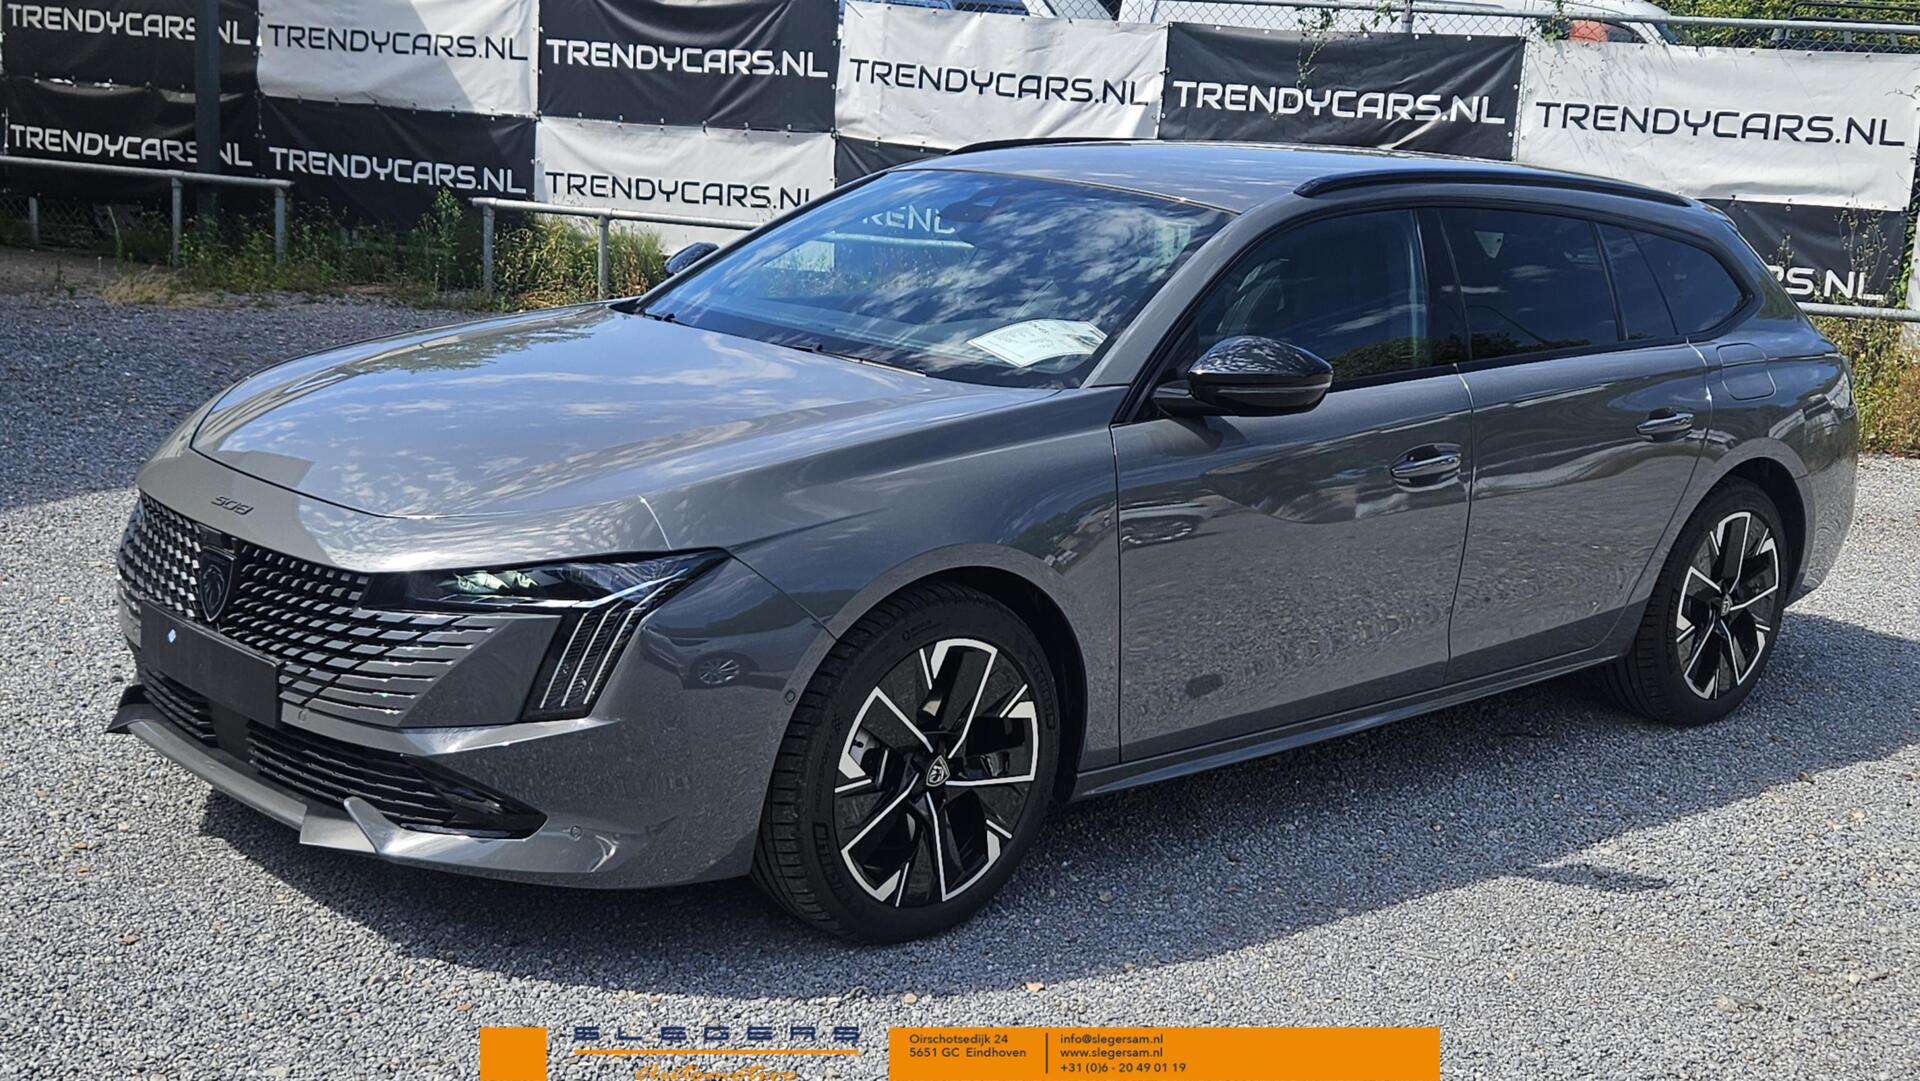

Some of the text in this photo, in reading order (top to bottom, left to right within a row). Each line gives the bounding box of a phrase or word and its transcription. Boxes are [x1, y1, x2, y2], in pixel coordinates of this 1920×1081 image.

[8, 3, 252, 46] TRENDYCARSNL
[267, 24, 528, 61] TRENDYCARS.NL
[546, 38, 828, 78] TRENDYCARS.NL
[849, 57, 1149, 106] TRENDYCARS.NL
[1173, 80, 1505, 125] TRENDYCARS.NL
[10, 123, 253, 167] TRENDYCARSNL
[1536, 101, 1904, 146] TRENDYCARS.NL
[269, 146, 526, 194] TRENDYCARS.NL
